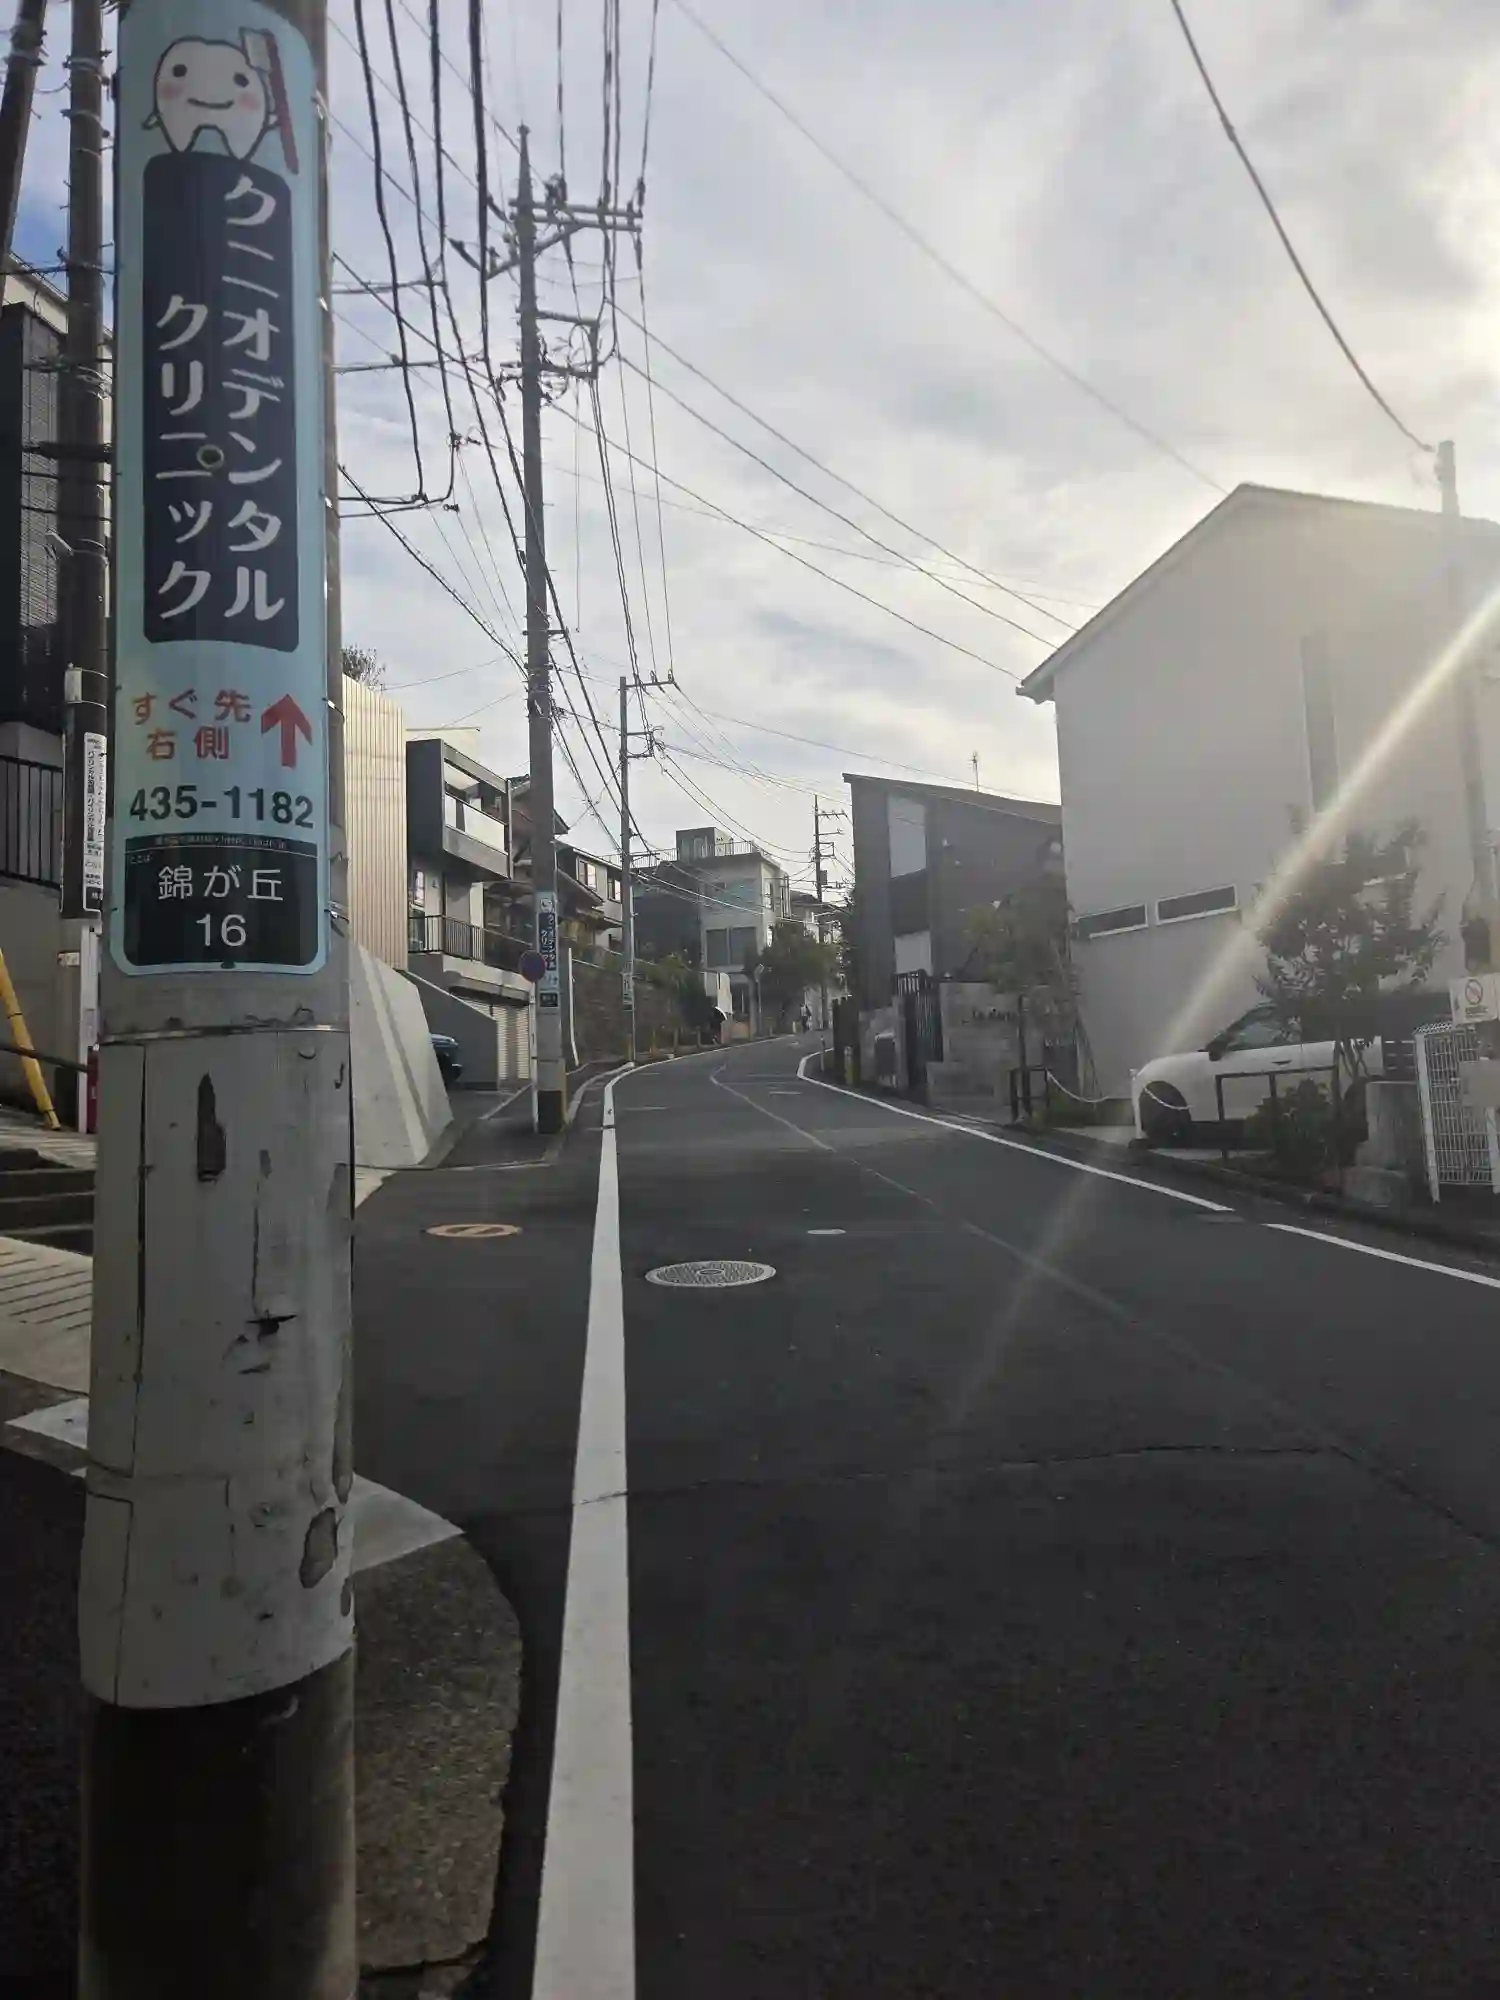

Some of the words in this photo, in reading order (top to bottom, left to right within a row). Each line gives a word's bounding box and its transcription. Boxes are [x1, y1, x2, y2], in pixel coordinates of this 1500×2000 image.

[223, 175, 285, 620] クニオデンタル
[156, 295, 212, 618] クリニック
[133, 688, 252, 725] すぐ先
[146, 727, 230, 760] 右側
[130, 785, 313, 828] 435-1182
[158, 865, 284, 901] 錦が丘
[196, 914, 247, 947] 16
